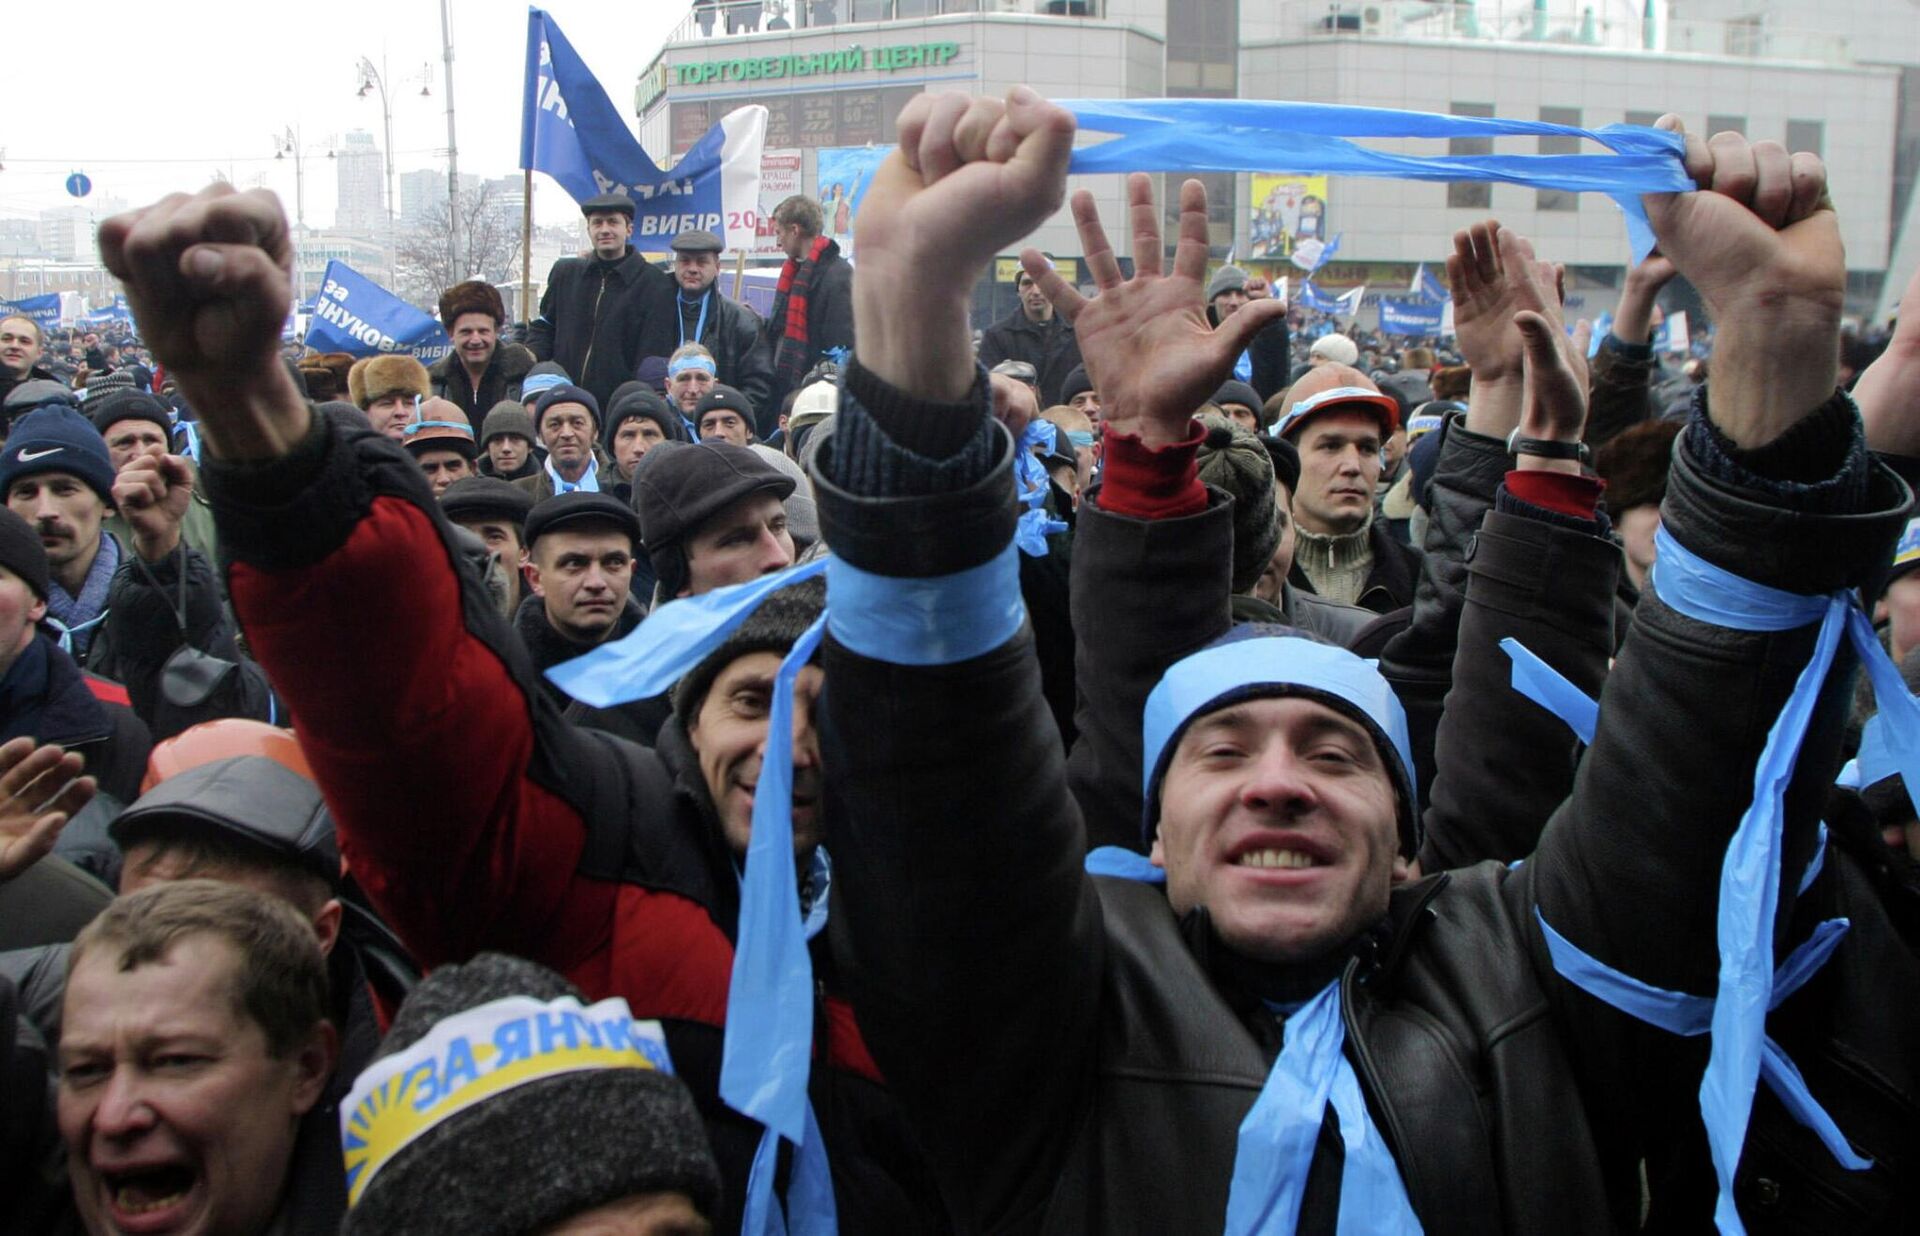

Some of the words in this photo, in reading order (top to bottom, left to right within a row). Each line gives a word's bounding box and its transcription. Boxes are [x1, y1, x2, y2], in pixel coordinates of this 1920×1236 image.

[676, 45, 863, 84] ТОРГОВЕЛЬНИЙ
[873, 43, 958, 72] ЦЕНТР
[641, 212, 721, 236] ВИБІР
[323, 279, 349, 302] за
[410, 1037, 478, 1111] ЗА
